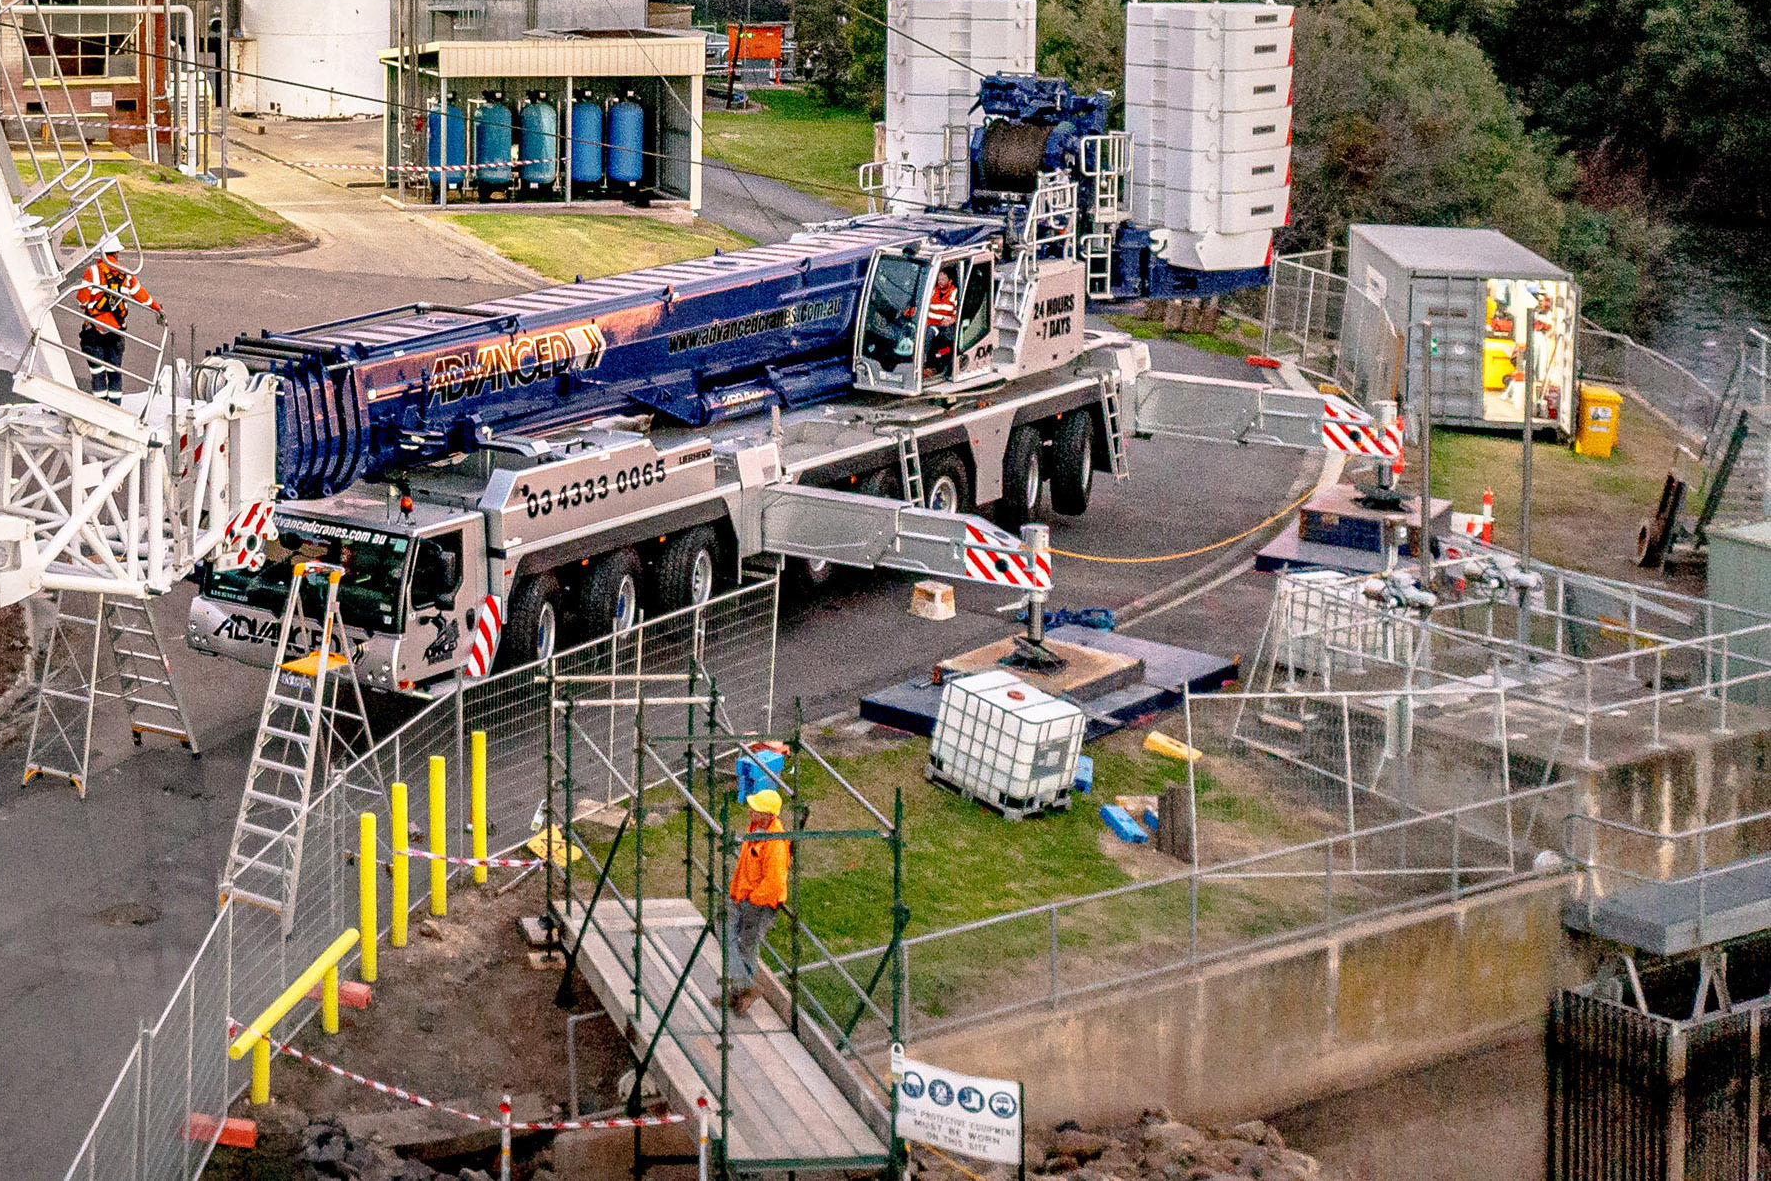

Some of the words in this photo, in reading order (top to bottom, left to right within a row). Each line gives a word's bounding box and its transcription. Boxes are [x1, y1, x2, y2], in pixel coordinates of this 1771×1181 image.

[1033, 301, 1044, 320] 24
[1047, 294, 1075, 317] HOURS
[1049, 316, 1071, 338] DAYS
[428, 331, 572, 409] ADVANCED
[678, 448, 712, 465] LIEBHERR
[527, 488, 553, 519] 03
[557, 475, 608, 510] 4333
[616, 459, 666, 494] 0065
[914, 1119, 942, 1132] MUST
[948, 1127, 960, 1136] BE
[968, 1132, 1000, 1145] WORN
[920, 1111, 965, 1128] PROTECTIVE
[970, 1123, 1016, 1138] EQUIPMENT
[926, 1131, 939, 1140] ON
[969, 1143, 988, 1152] SITE
